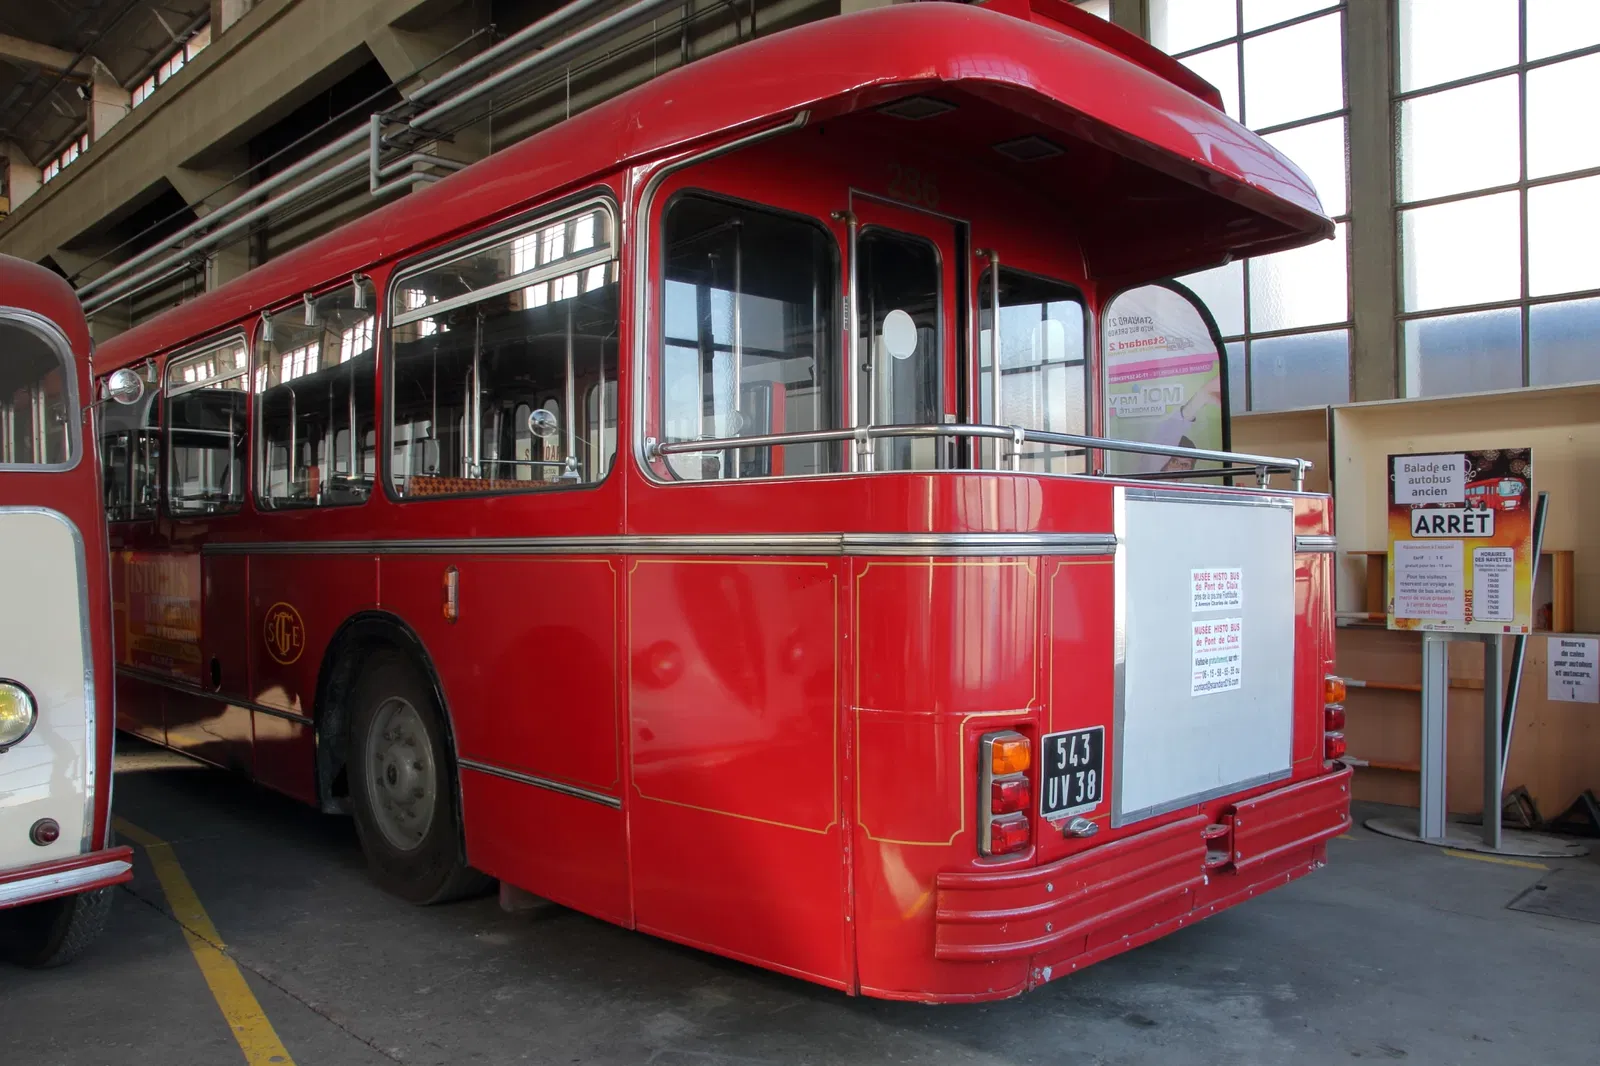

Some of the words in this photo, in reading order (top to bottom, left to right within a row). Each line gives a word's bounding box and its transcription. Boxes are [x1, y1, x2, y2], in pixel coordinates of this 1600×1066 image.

[887, 162, 939, 208] 286
[1404, 462, 1440, 474] Balade
[1442, 463, 1456, 472] en
[1408, 475, 1452, 485] autobus
[1411, 487, 1448, 497] ancien
[1414, 507, 1490, 534] ARRÊT
[1193, 571, 1210, 581] MUSÉE
[1213, 572, 1227, 580] HISTO
[1230, 572, 1239, 580] BUS
[1195, 582, 1201, 591] de
[1204, 582, 1215, 591] Pont
[1218, 582, 1224, 590] de
[1226, 581, 1238, 589] Claix
[1194, 624, 1211, 635] MUSÉE
[1214, 624, 1228, 633] HISTO
[1230, 623, 1240, 632] BUS
[1196, 637, 1202, 646] de
[1205, 636, 1216, 646] Pont
[1219, 636, 1225, 644] de
[1227, 634, 1238, 643] Claix
[1057, 733, 1091, 769] 543
[1048, 774, 1071, 809] UV
[1075, 769, 1097, 802] 38
